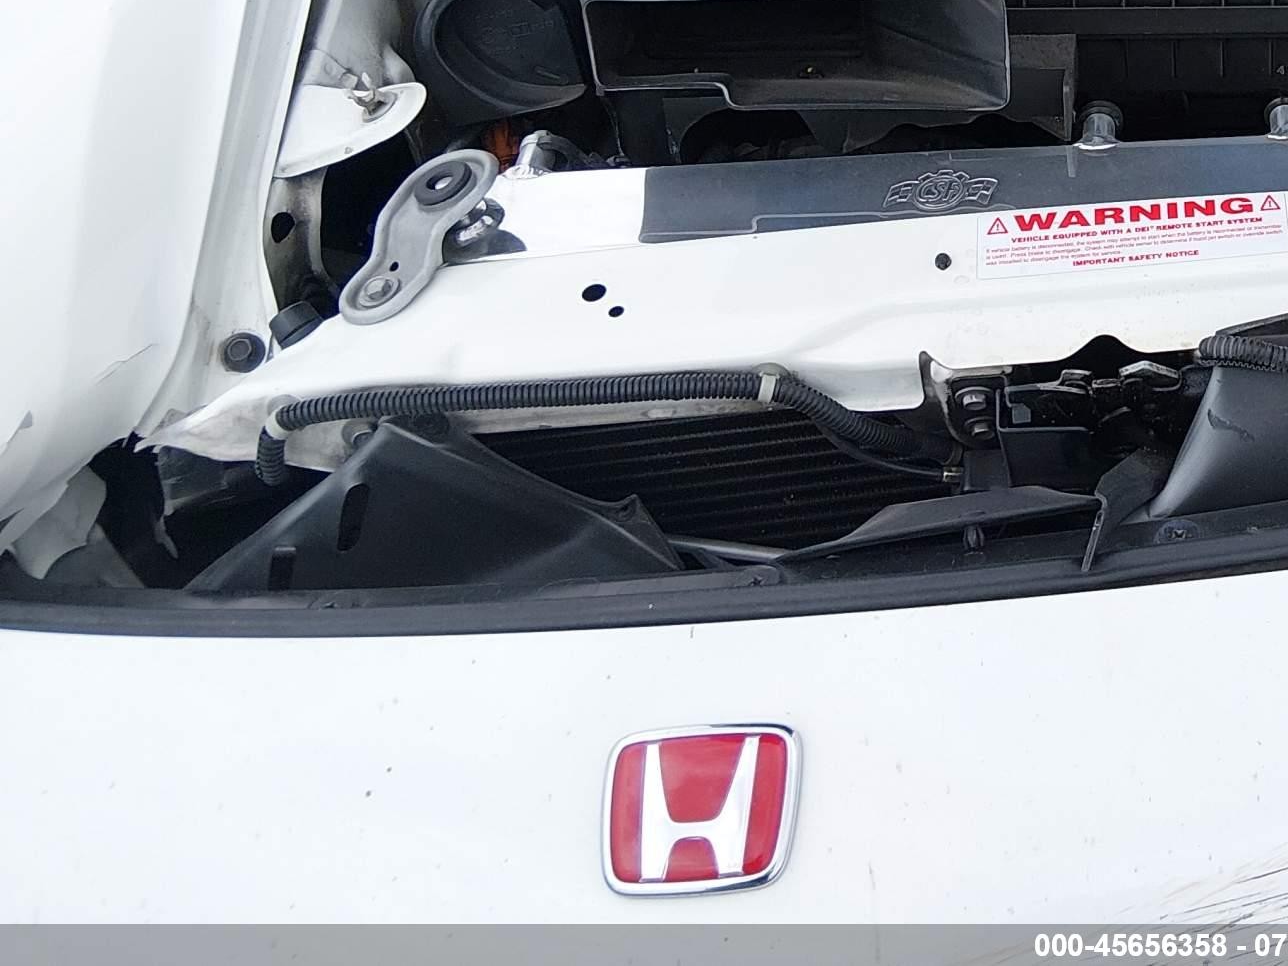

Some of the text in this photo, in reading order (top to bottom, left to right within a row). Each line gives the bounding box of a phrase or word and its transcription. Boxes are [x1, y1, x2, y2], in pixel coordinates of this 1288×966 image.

[920, 182, 960, 202] CSF
[1014, 197, 1254, 232] WARNING
[1012, 235, 1050, 243] VEHICLE
[1053, 231, 1097, 240] EQUIPPED
[1100, 228, 1122, 236] WITH
[1073, 250, 1198, 267] IMPORTANT SAFETY NOTICE
[640, 734, 761, 884] H
